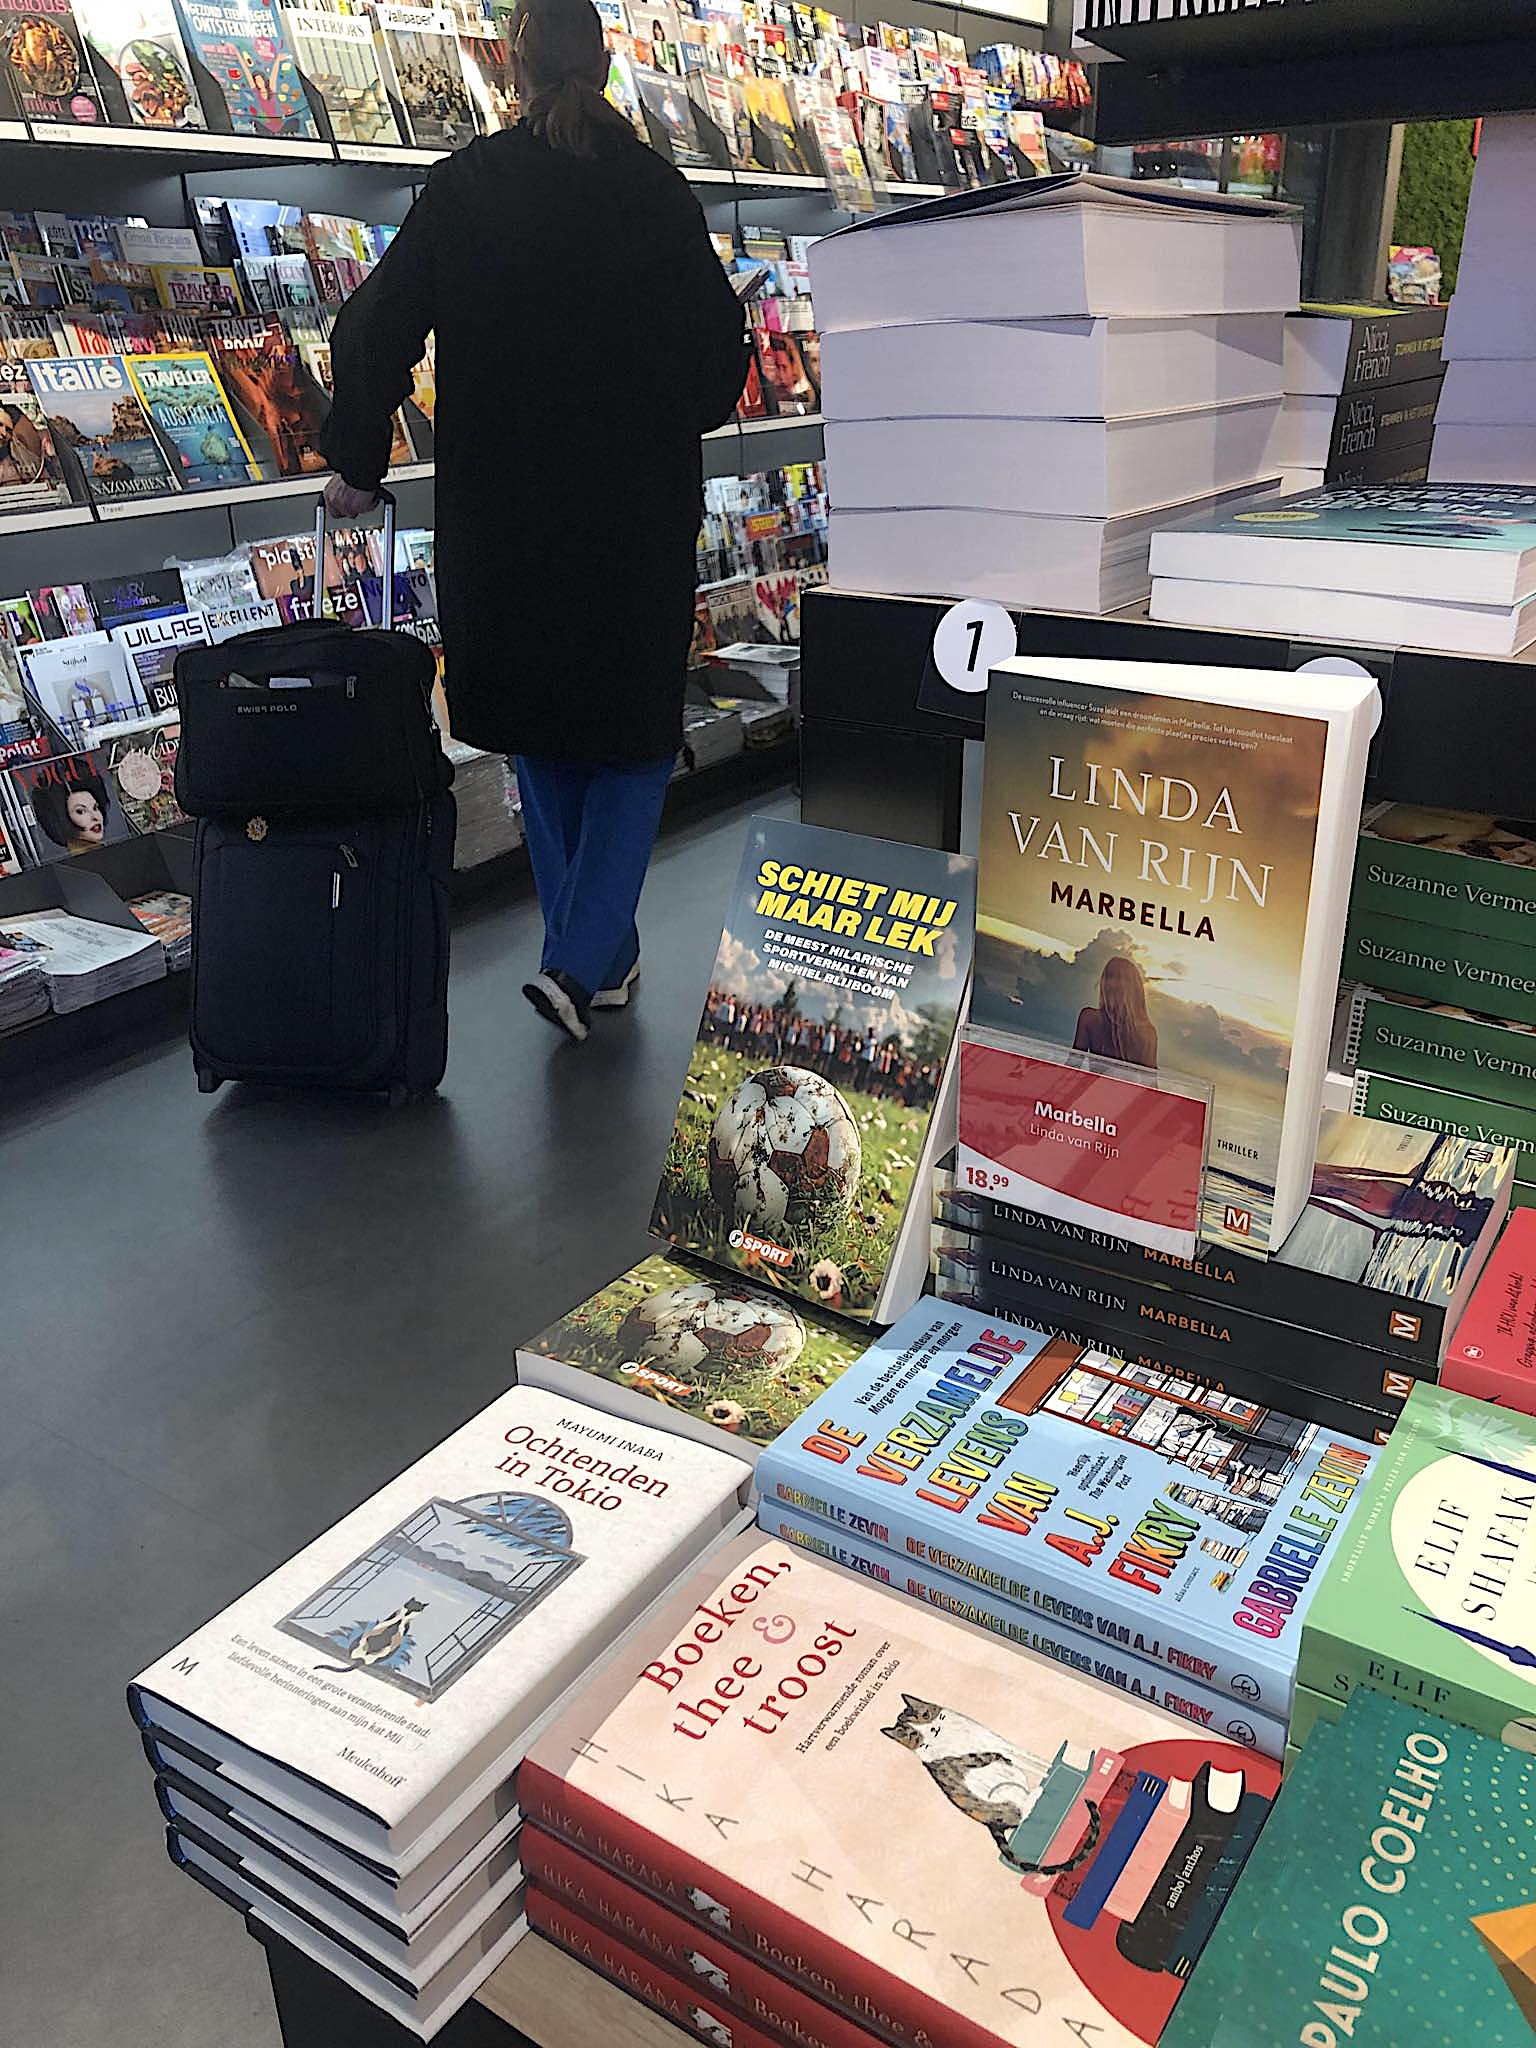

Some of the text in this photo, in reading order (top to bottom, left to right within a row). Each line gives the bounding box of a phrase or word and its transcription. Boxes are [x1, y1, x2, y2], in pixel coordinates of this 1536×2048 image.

[31, 359, 125, 393] Italië
[138, 369, 213, 388] TRAVELLER
[1353, 349, 1391, 383] French
[159, 404, 228, 428] AUSTRALIA
[1338, 423, 1377, 456] French
[965, 619, 985, 674] 1
[269, 703, 298, 713] POLO
[1049, 755, 1243, 834] LINDA
[1007, 811, 1274, 908] VAN RIJN
[1367, 863, 1458, 899] Suzanne
[755, 890, 944, 957] MAAR LEK
[757, 859, 958, 927] SCHIET MIJ
[1051, 880, 1216, 942] MARBELLA
[763, 942, 909, 990] SPORTVERHALEN VAN
[764, 928, 914, 976] DE MEEST HILARISCHE
[768, 958, 896, 1000] MICHIEL BLIJBOOM
[1358, 938, 1447, 974] Suzanne
[1375, 1026, 1466, 1063] Suzanne
[1029, 1123, 1119, 1160] Linda van Rijn
[1034, 1100, 1118, 1137] Marbella
[1379, 1101, 1470, 1138] Suzanne
[1216, 1138, 1259, 1161] THRILLER
[993, 1203, 1236, 1285] LINDA VAN RIJN MARBELLA
[1225, 1207, 1250, 1230] M
[742, 1236, 790, 1265] SPORT
[990, 1261, 1232, 1344] LINDA VAN RIJN MARBELLA
[1392, 1313, 1418, 1339] M
[636, 1367, 689, 1394] SPORT
[854, 1320, 945, 1405] Van de bestsellerauteur van
[867, 1321, 964, 1416] Morgen en morgen en morgen
[1385, 1371, 1410, 1398] M
[856, 1328, 1028, 1486] VERZAMELDE
[504, 1425, 669, 1499] Ochtenden
[556, 1417, 665, 1462] MAYUMI INABA
[801, 1418, 868, 1465] DE
[916, 1410, 1029, 1514] LEVENS
[494, 1451, 623, 1511] in Tokio
[976, 1470, 1060, 1537] VAN
[1088, 1454, 1128, 1500] The Washington
[1115, 1473, 1133, 1491] Post
[1044, 1506, 1120, 1568] A.J.
[1107, 1498, 1202, 1595] FIKRY
[1233, 1442, 1373, 1640] GABRIELLE ZEVIN
[1414, 1498, 1470, 1580] ELIF
[1461, 1486, 1536, 1622] SHAFAK
[776, 1482, 1219, 1682] GABRIELLE ZEVIN DE VERZAMELDE LEVENS VAN A.J. FIKRY
[637, 1561, 792, 1694] Boeken,
[778, 1523, 1214, 1725] GABRIELLE ZEVIN DE VERZAMELDE LEVENS VAN A.J. FIKRY
[171, 1656, 200, 1676] M
[227, 1652, 387, 1737] liefdevolle herinneringen aan mijn kat
[230, 1634, 408, 1726] Een leven samen in een grote veranderende
[673, 1614, 797, 1740] thee &
[743, 1619, 857, 1735] troost
[1368, 1659, 1452, 1706] ELIF
[795, 1641, 892, 1755] Hartverwarmende roman over
[825, 1659, 901, 1752] een boekwinkel in Tokio
[336, 1746, 407, 1789] Meulenhoff
[541, 1803, 905, 2034] HIKA HARADA Boeken, thee
[543, 1863, 678, 1958] HIKA HARADA
[1299, 1732, 1449, 2048] PAULO COELHO
